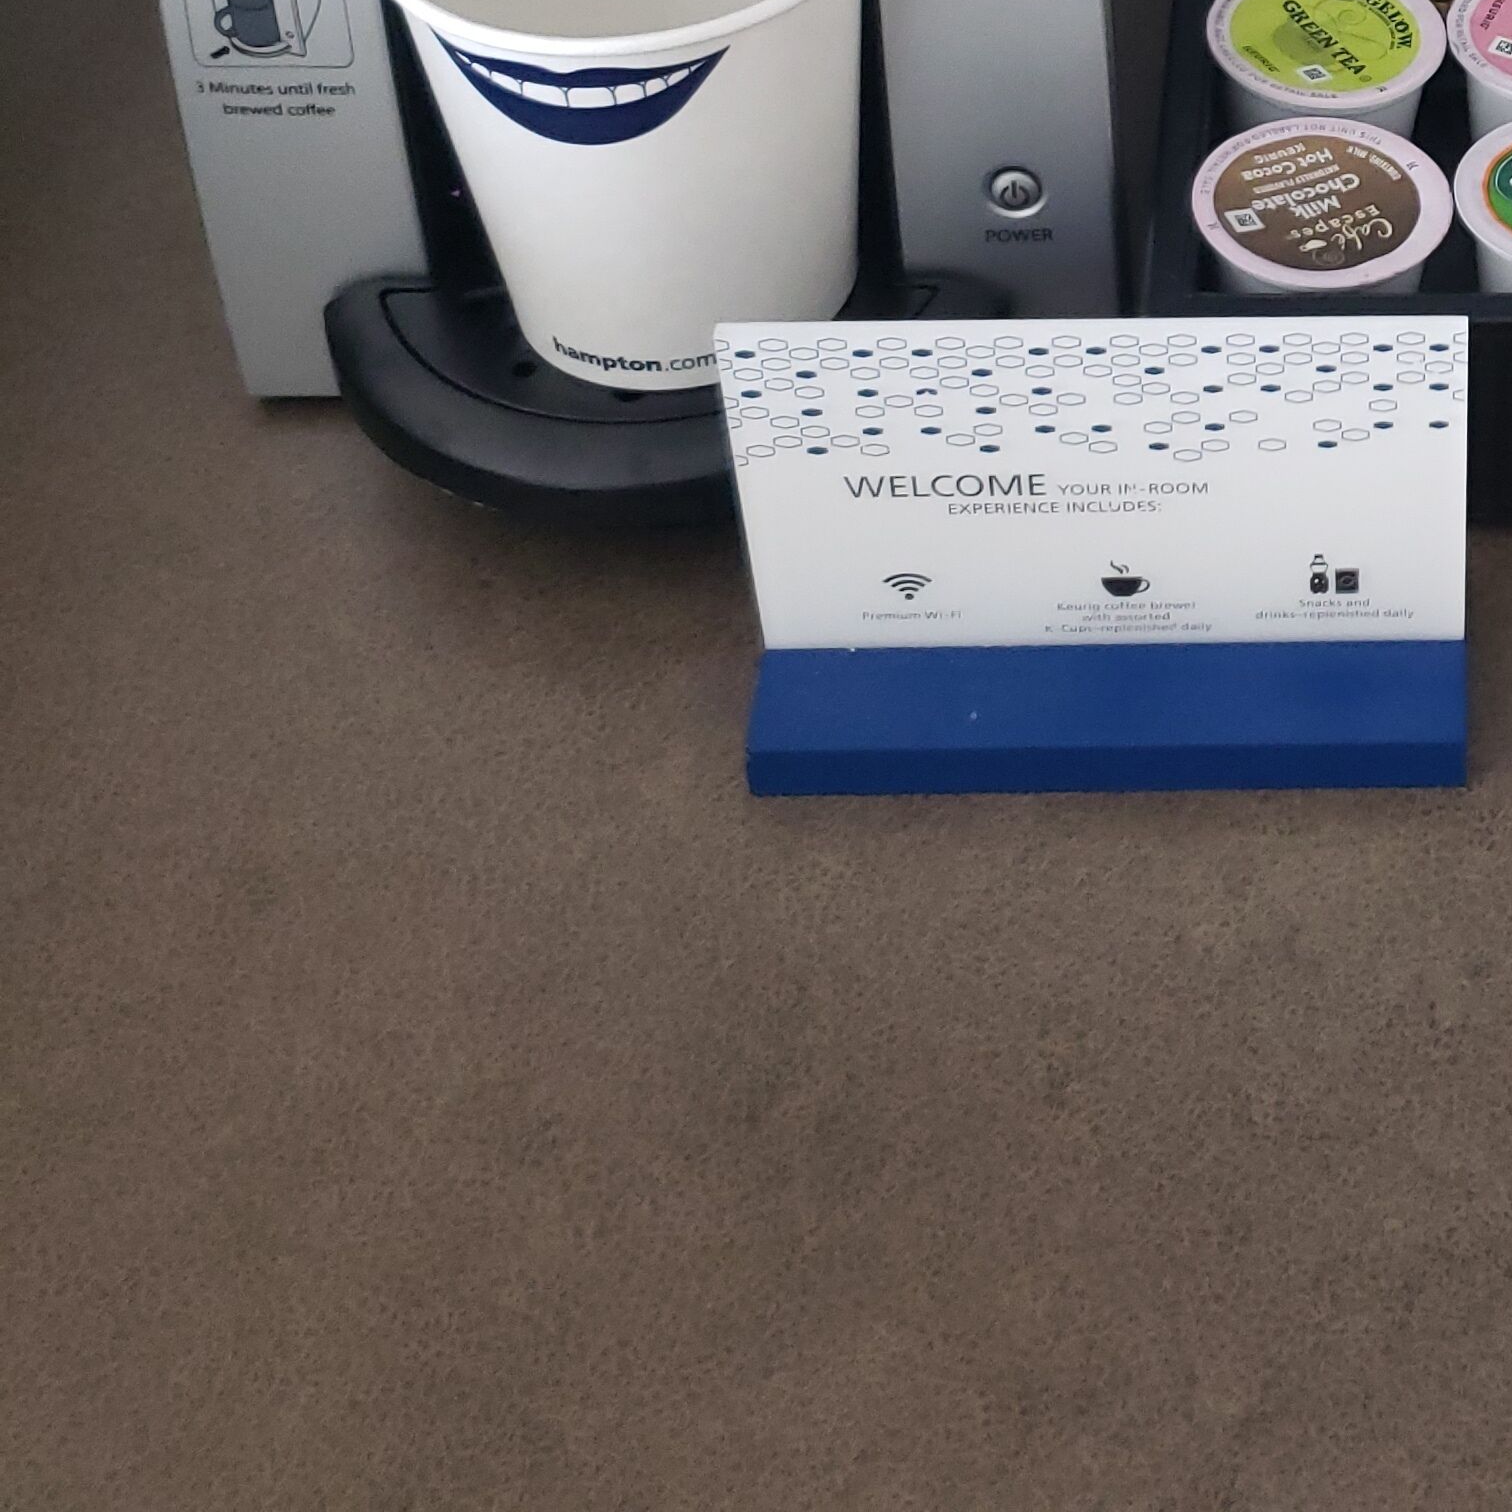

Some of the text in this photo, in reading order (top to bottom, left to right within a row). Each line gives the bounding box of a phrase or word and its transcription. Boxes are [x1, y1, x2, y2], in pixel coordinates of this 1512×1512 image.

[1282, 0, 1339, 49] GREEN
[1331, 47, 1367, 75] TEA
[209, 81, 273, 95] Minutes
[278, 81, 314, 95] until
[316, 82, 355, 96] fresh
[223, 103, 336, 116] brewed coffee
[1254, 142, 1307, 164] KEURIG
[1300, 148, 1334, 168] Hot
[1346, 144, 1369, 159] MILK
[1240, 161, 1297, 181] Cocoa
[1251, 173, 1361, 211] Chocolate
[1295, 195, 1342, 220] Milk
[1290, 204, 1381, 239] Escapes
[985, 228, 1054, 243] POWER
[1330, 218, 1393, 251] Café
[552, 335, 718, 372] hampton.com
[843, 473, 1210, 499] WELCOME YOUR IN-ROOM
[948, 500, 1163, 516] EXPERIENCE INCLUDES:
[1298, 598, 1370, 608] Snacks and
[924, 609, 962, 620] Wi-Fi
[1383, 608, 1414, 619] daily
[1181, 622, 1213, 633] daily
